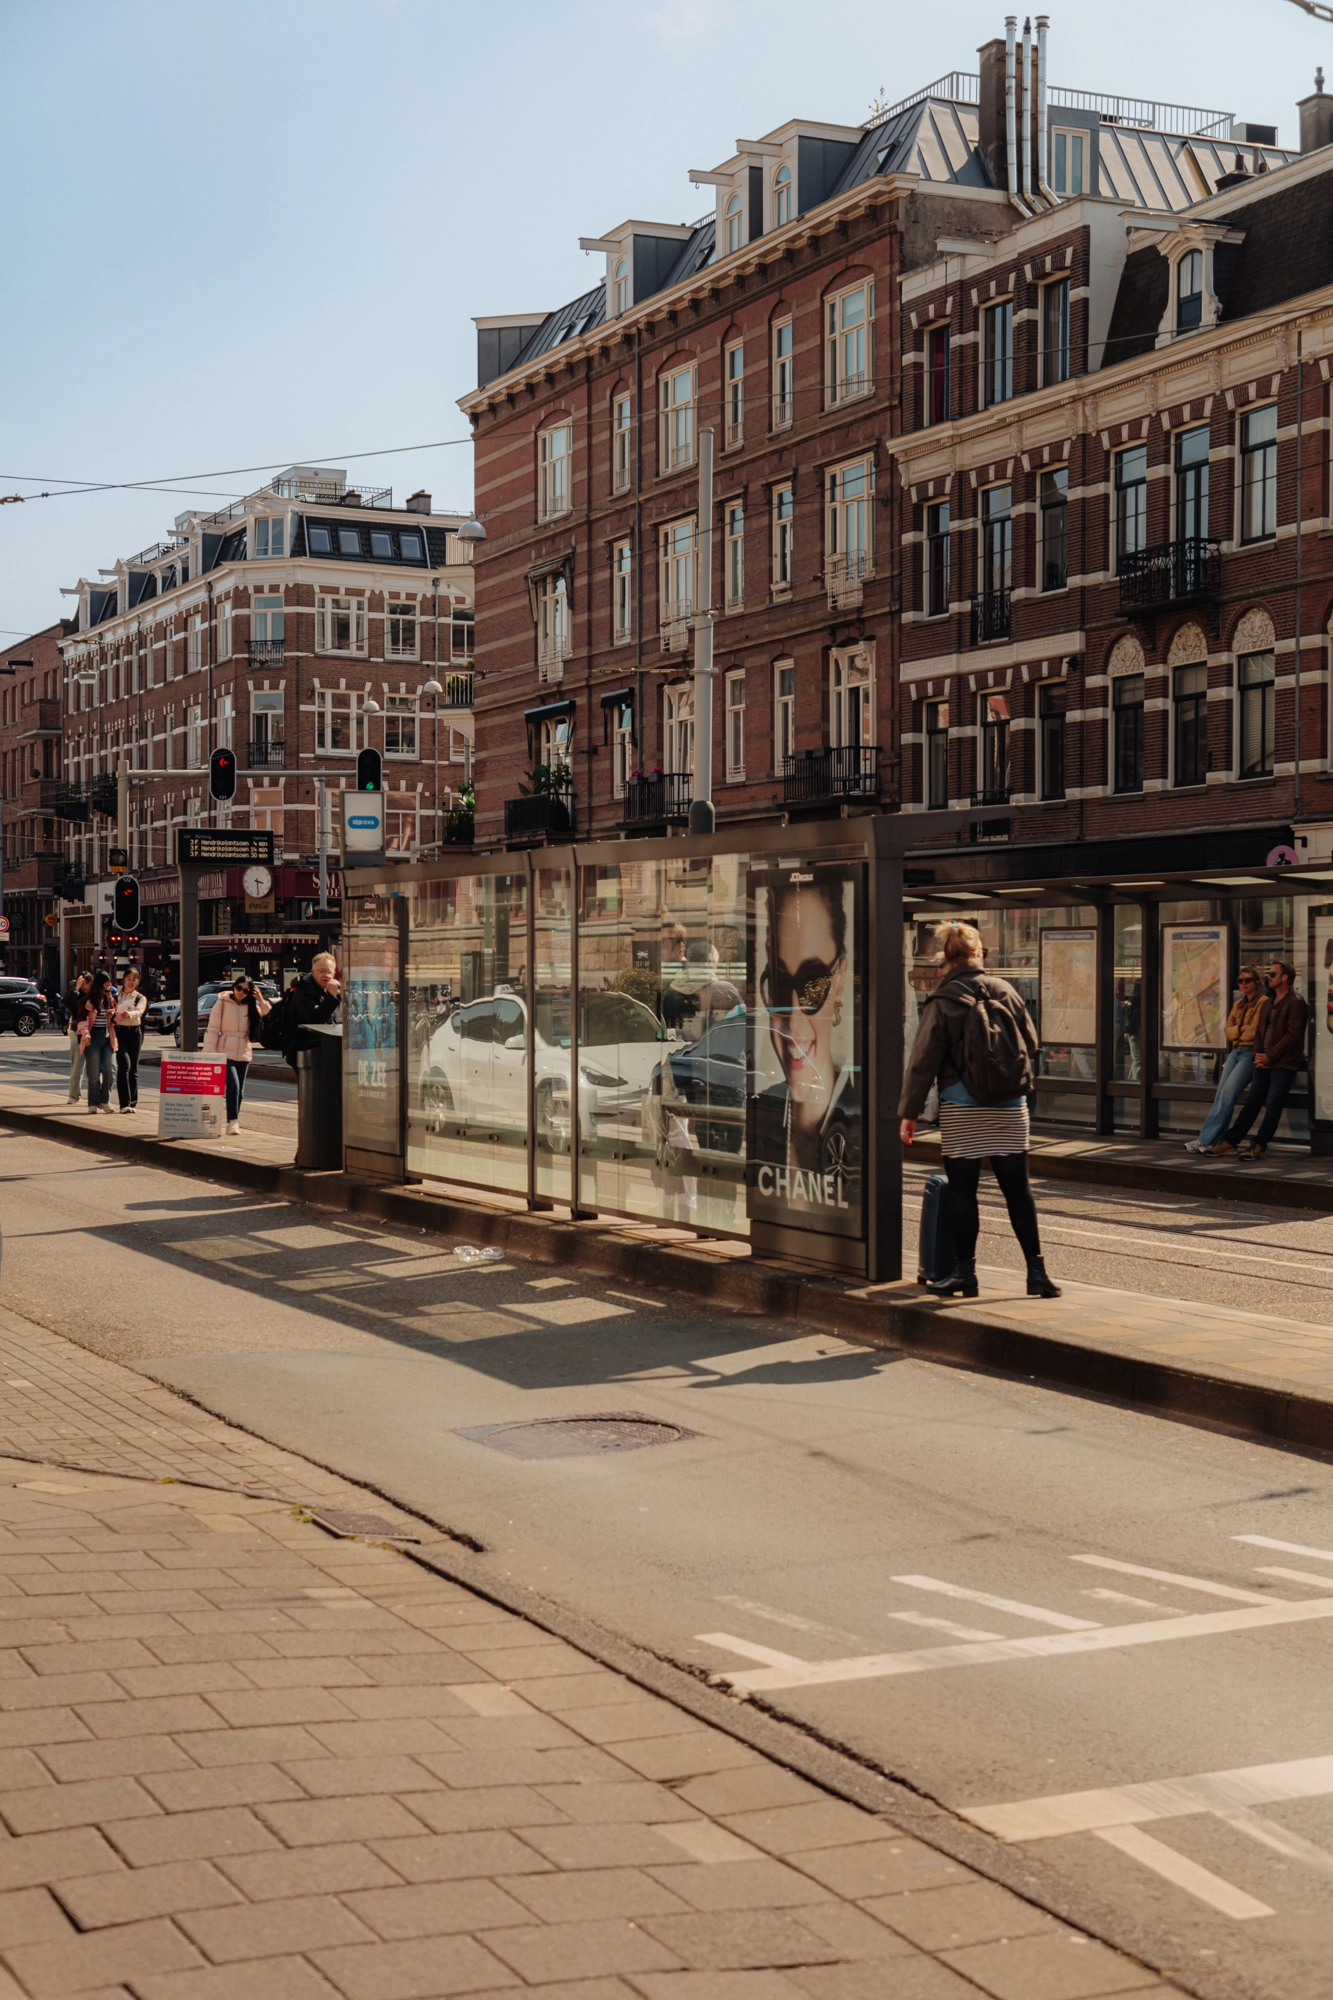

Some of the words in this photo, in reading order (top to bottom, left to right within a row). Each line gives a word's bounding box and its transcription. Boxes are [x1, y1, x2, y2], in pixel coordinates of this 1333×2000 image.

[790, 873, 814, 882] JCDecaux
[244, 943, 260, 953] SMALL
[260, 943, 272, 953] TALK
[358, 1060, 369, 1087] DE
[371, 1061, 387, 1088] ZEE
[758, 1165, 849, 1210] CHANEL
